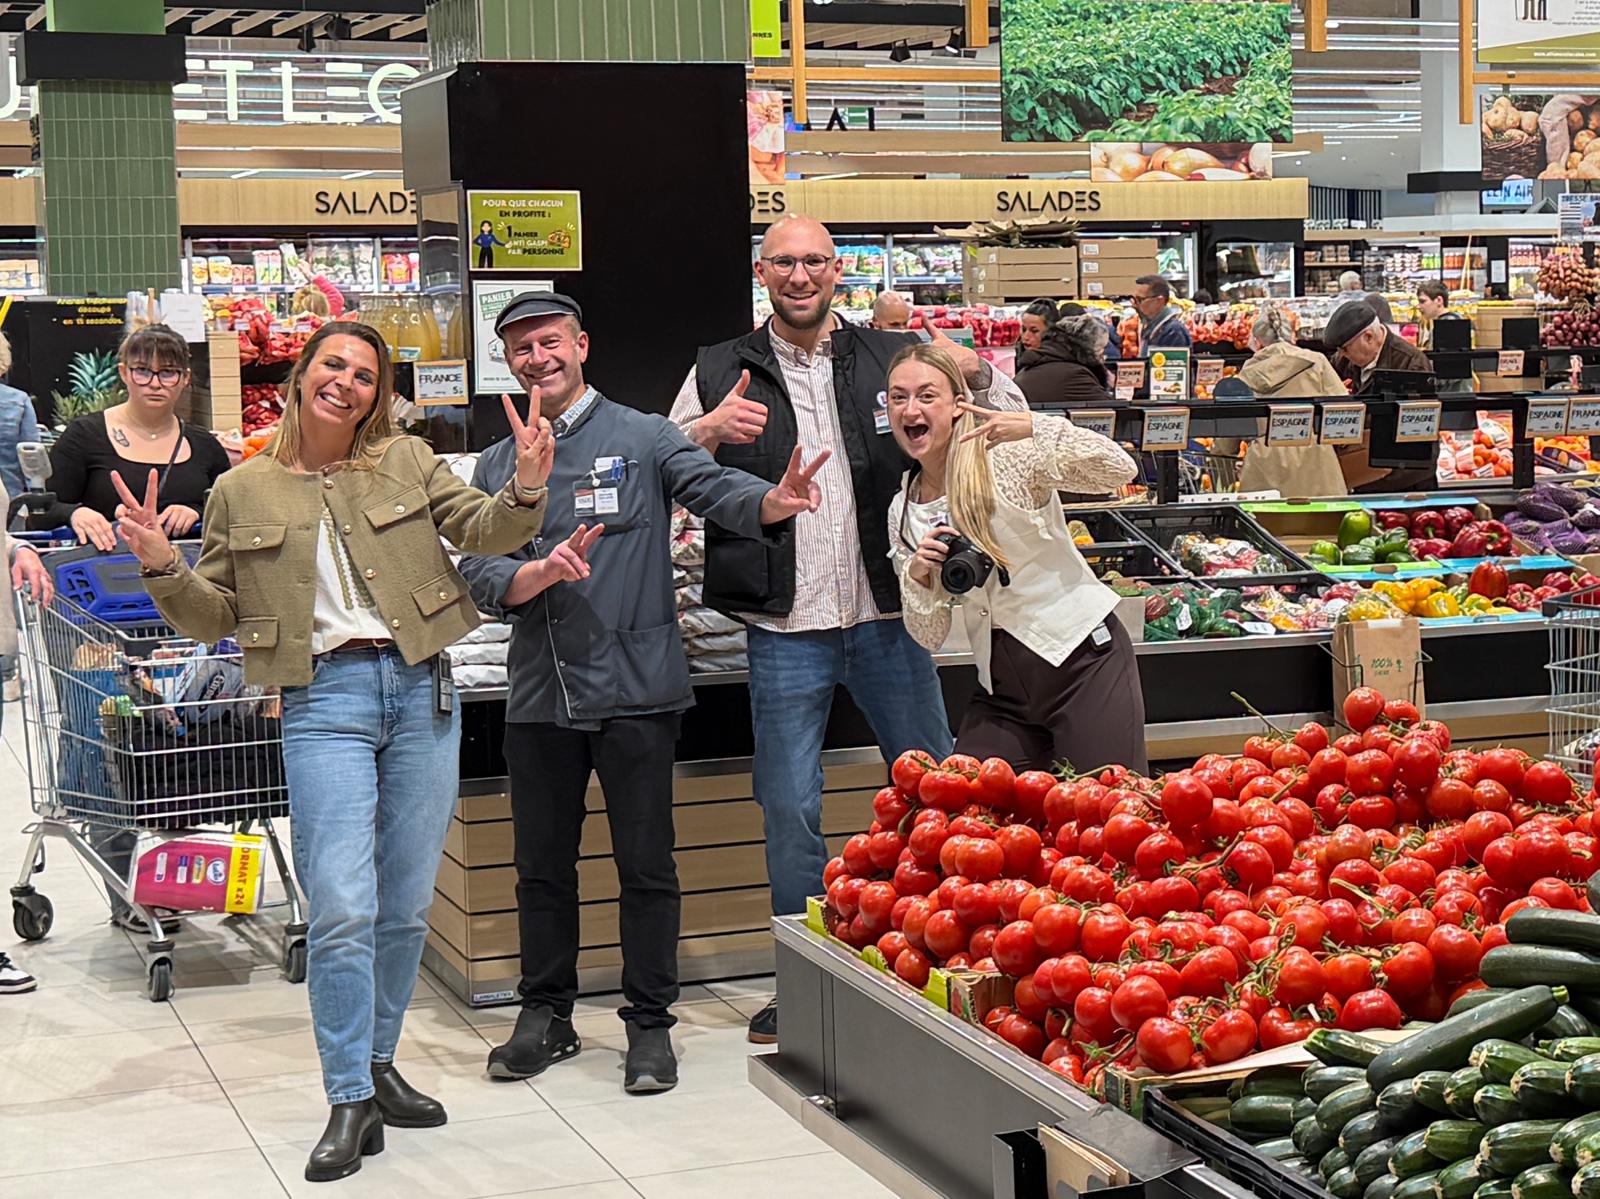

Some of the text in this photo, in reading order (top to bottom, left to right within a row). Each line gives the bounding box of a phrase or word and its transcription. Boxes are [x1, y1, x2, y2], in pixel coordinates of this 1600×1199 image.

[482, 199, 563, 207] POUR QUE CHACUN
[996, 190, 1101, 212] SALADES
[499, 210, 510, 218] EN
[512, 210, 546, 218] PROFITE
[506, 225, 513, 238] 1
[481, 290, 513, 304] PANIER
[418, 373, 461, 384] FRANCE
[1401, 414, 1435, 423] ESPAGNE
[1529, 410, 1564, 419] ESPAGNE
[1272, 417, 1310, 427] ESPAGNE
[1324, 416, 1360, 425] ESPAGNE
[1147, 421, 1184, 431] ESPAGNE
[1371, 657, 1393, 669] 100%
